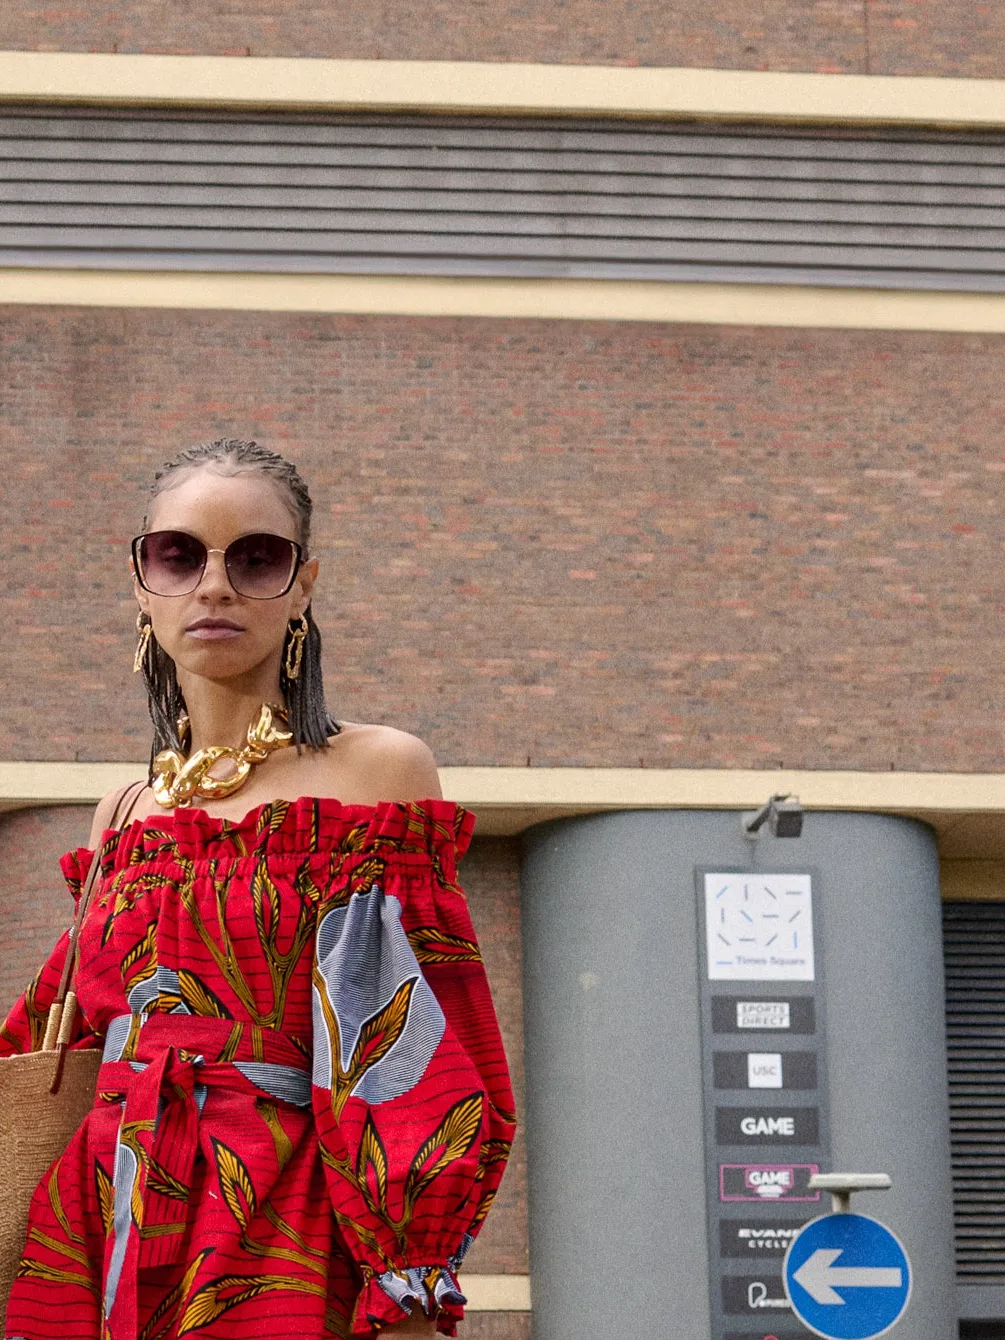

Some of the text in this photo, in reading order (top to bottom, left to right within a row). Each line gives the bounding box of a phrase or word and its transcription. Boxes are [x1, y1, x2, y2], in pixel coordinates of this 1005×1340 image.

[742, 1004, 785, 1013] SPORTS
[742, 1016, 785, 1025] DIRECT
[752, 1066, 777, 1076] USC
[740, 1117, 795, 1135] GAME
[748, 1171, 790, 1186] GAME
[748, 1240, 788, 1249] CYCLE
